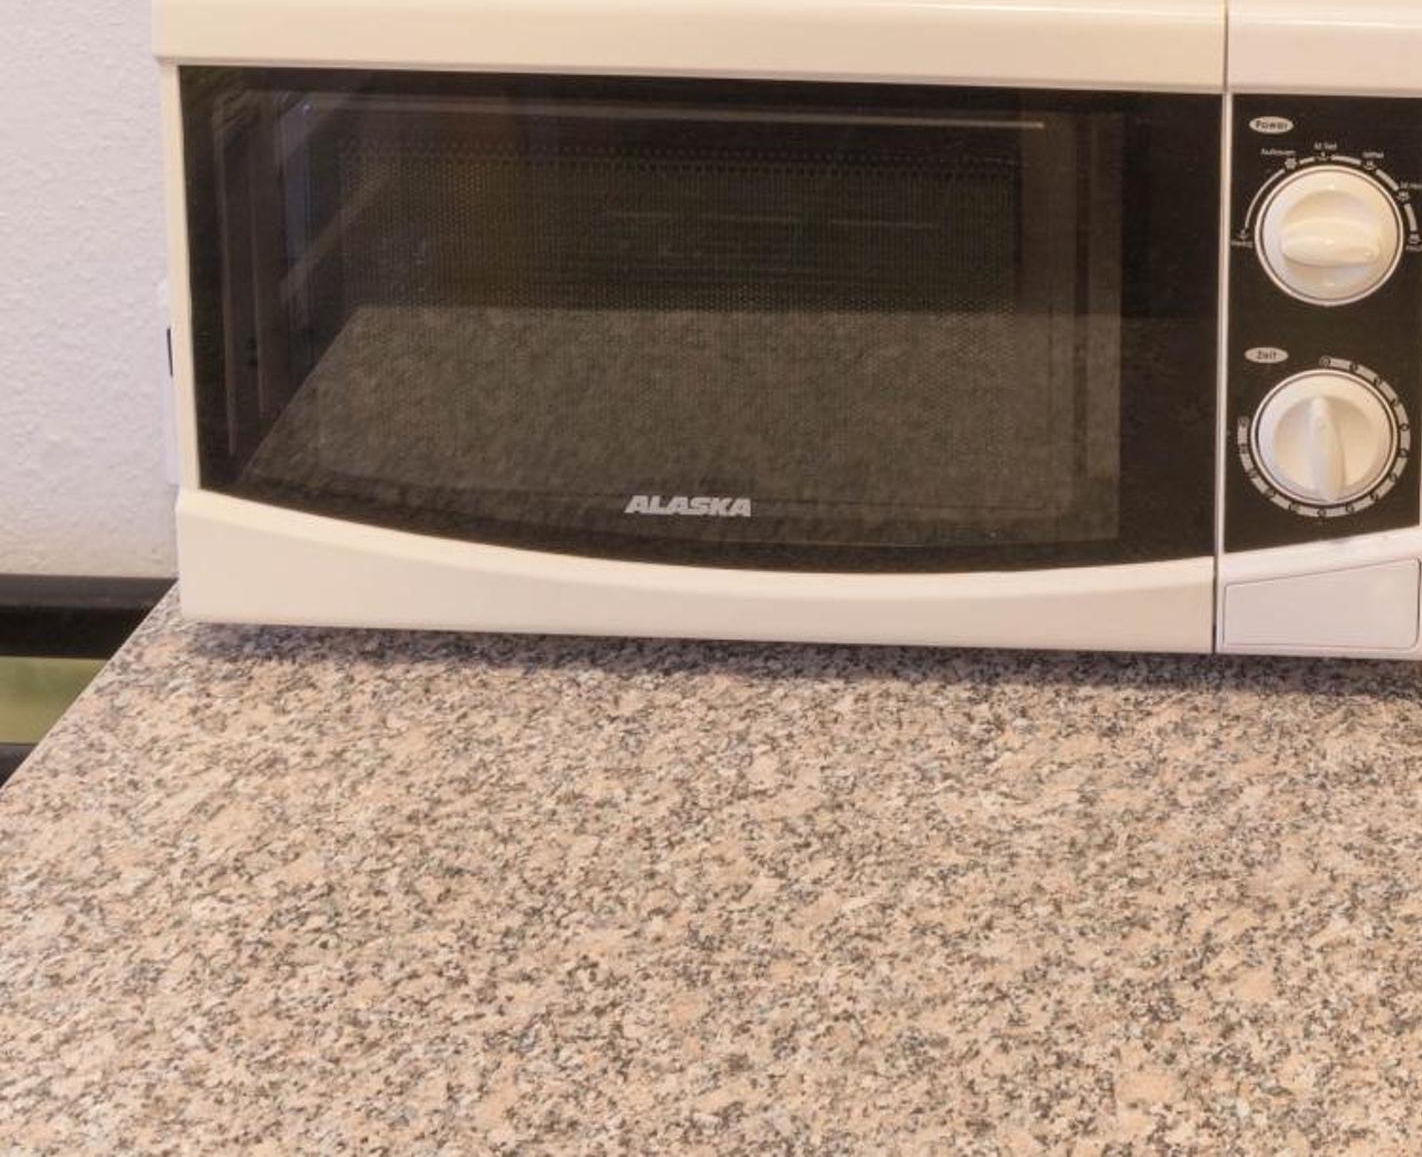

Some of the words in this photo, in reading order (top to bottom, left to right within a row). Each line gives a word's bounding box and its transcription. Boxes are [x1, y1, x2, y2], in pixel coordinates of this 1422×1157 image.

[1255, 119, 1289, 130] Power
[1256, 350, 1278, 361] Zeit
[623, 495, 752, 517] ALASKA
